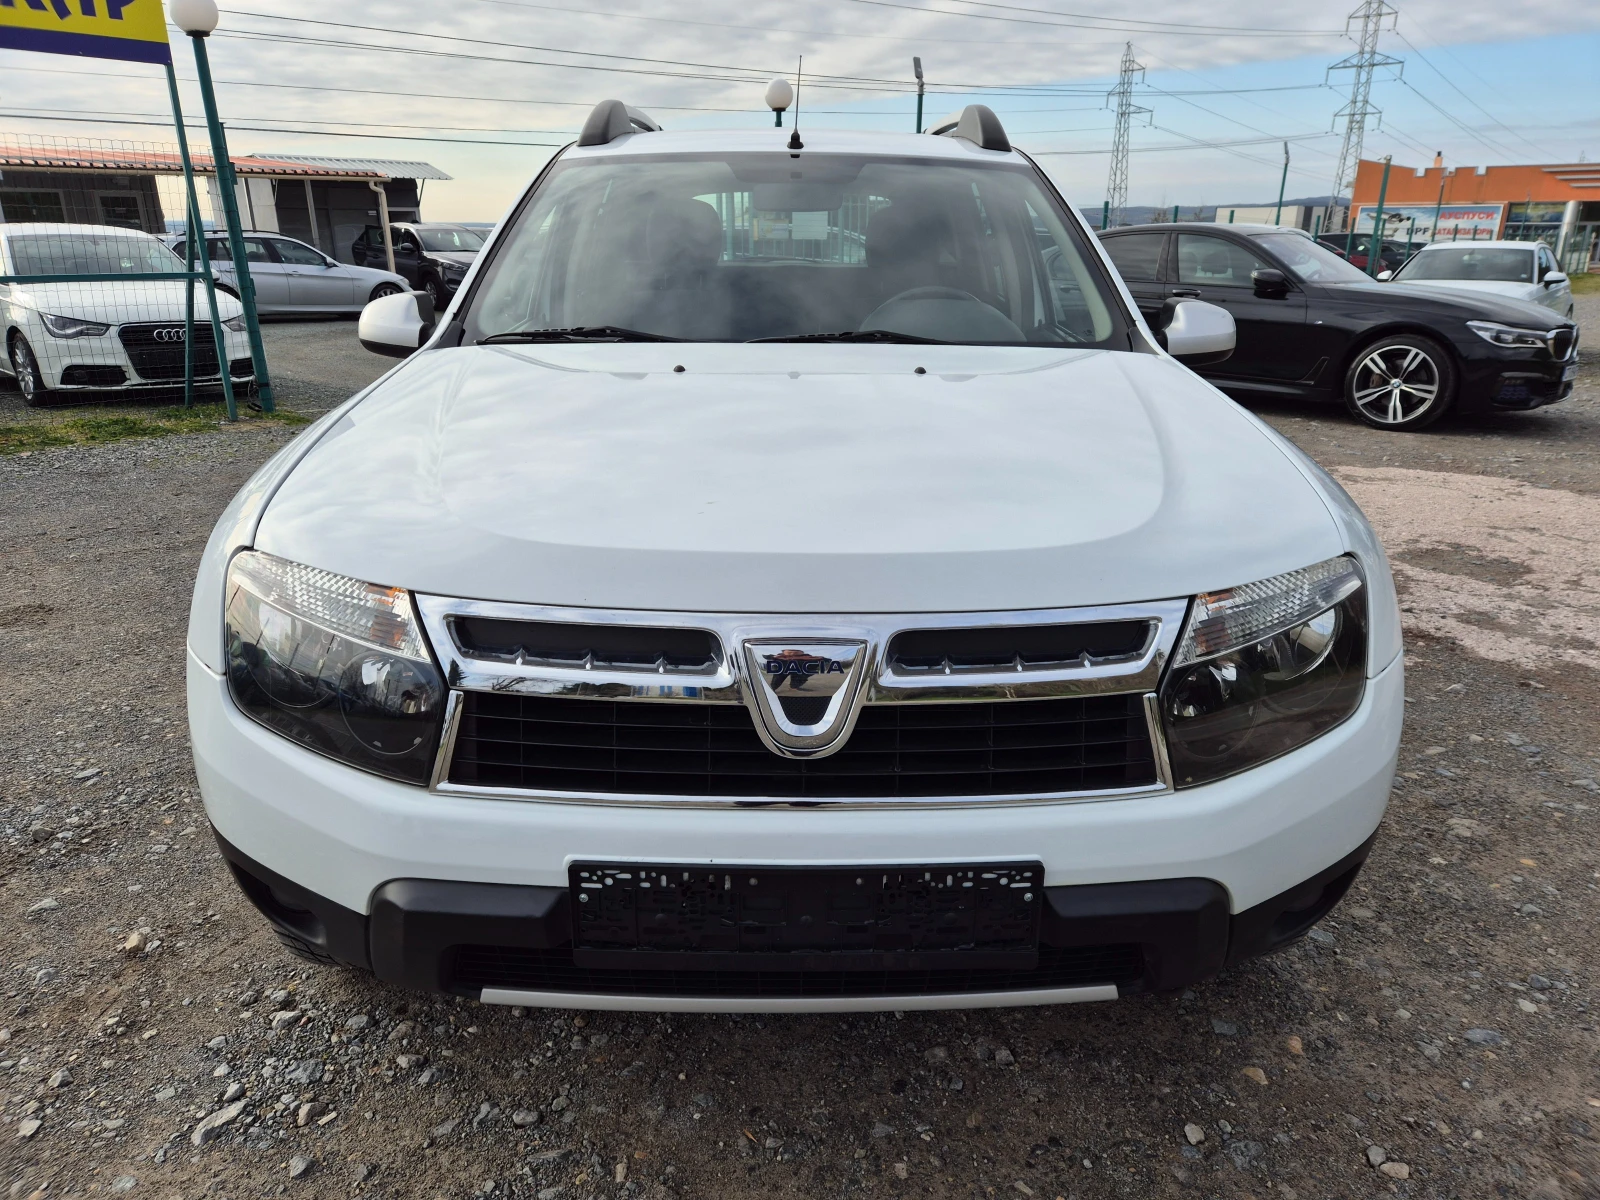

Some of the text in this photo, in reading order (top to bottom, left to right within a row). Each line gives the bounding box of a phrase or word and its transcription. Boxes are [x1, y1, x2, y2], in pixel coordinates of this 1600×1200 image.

[1439, 211, 1495, 220] АУСПУСИ
[1406, 227, 1430, 236] DPF
[766, 660, 845, 674] DACIA
